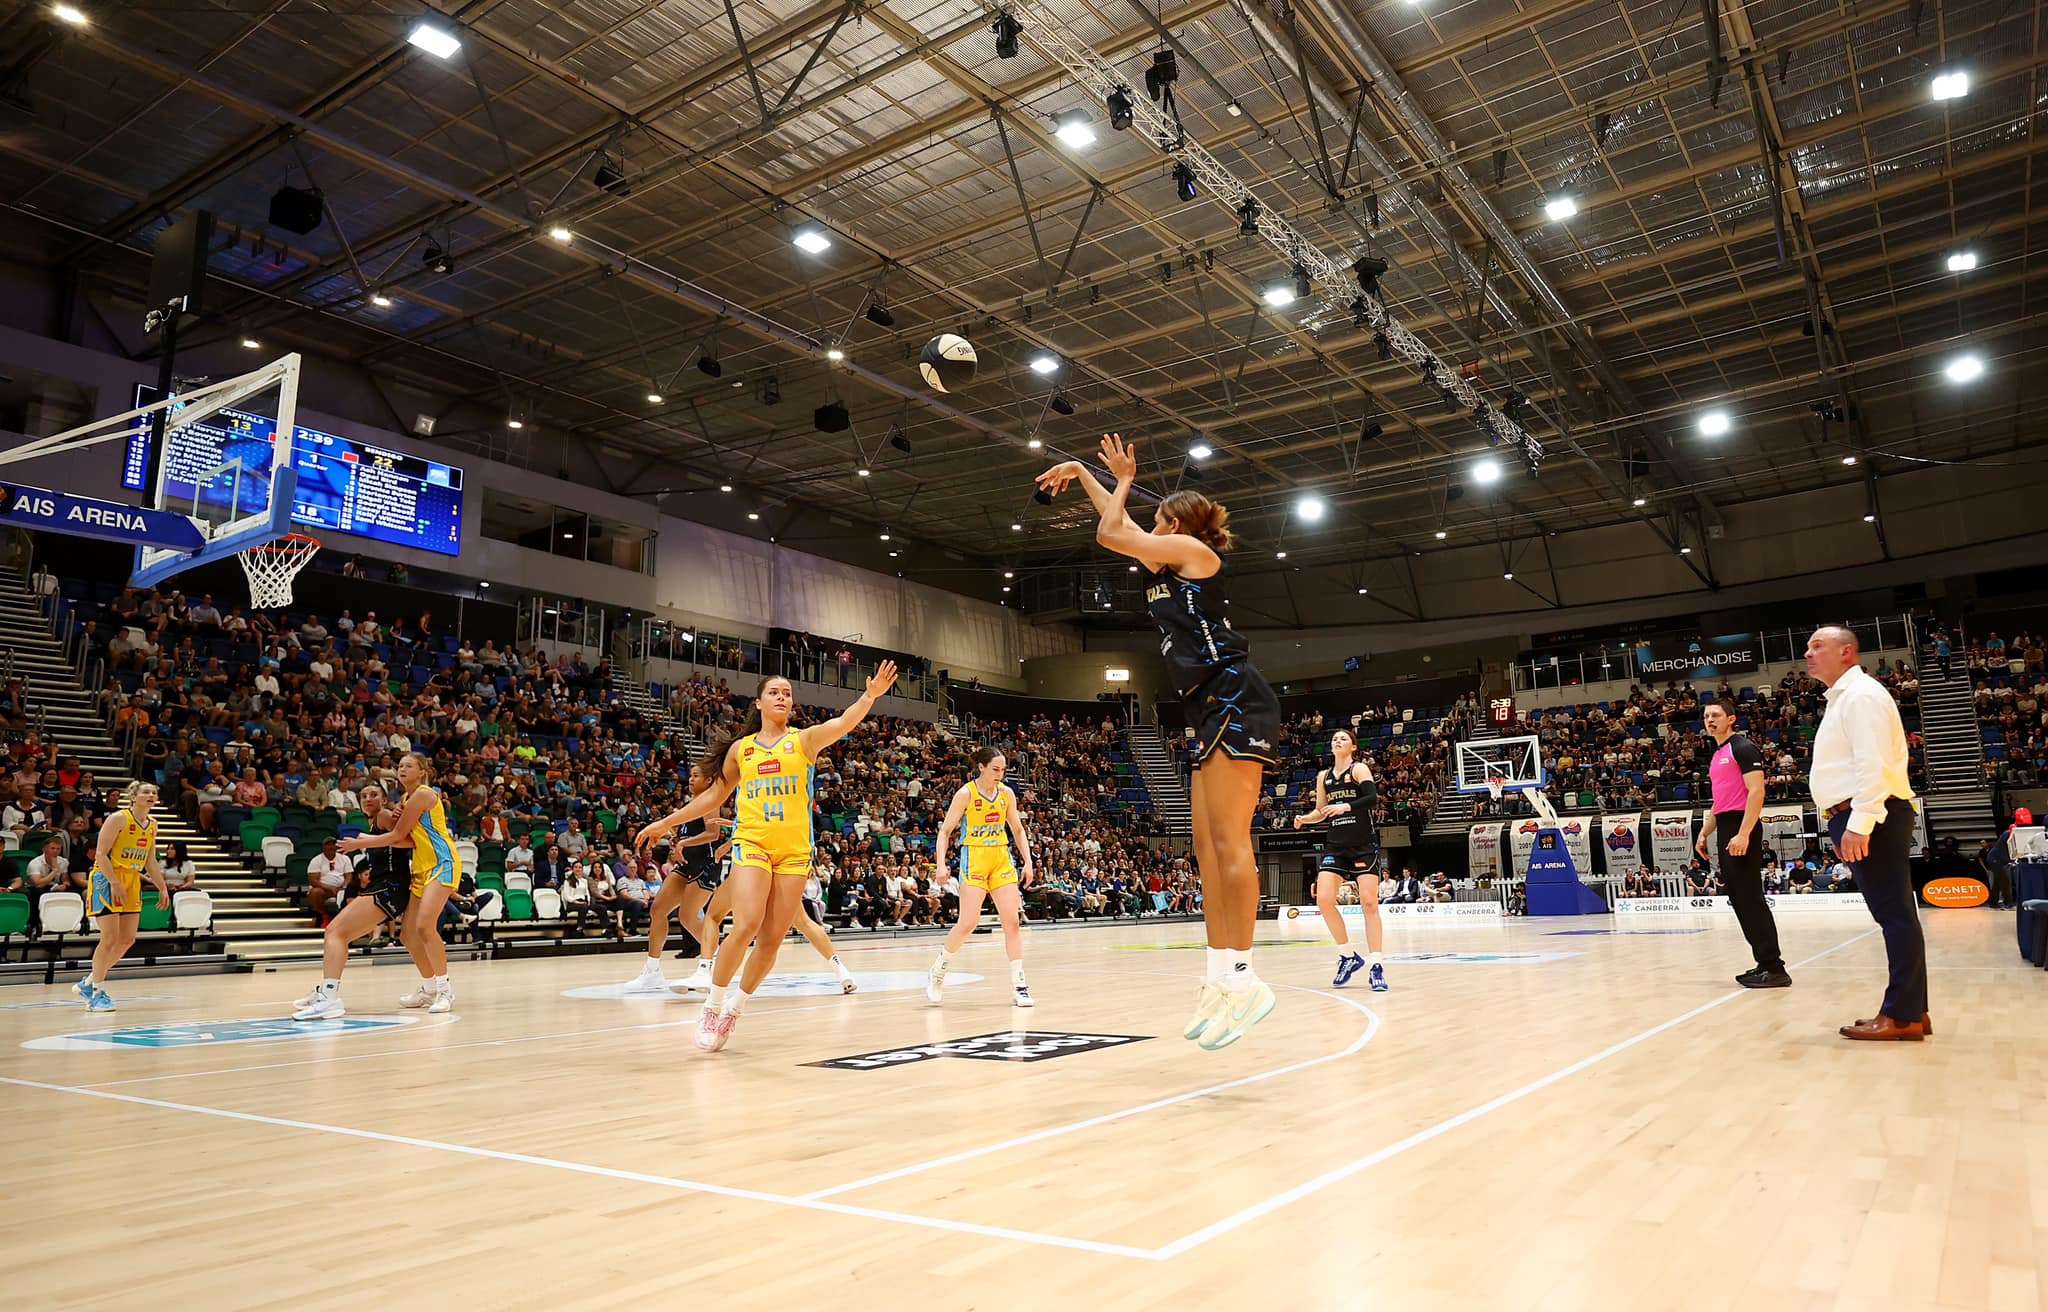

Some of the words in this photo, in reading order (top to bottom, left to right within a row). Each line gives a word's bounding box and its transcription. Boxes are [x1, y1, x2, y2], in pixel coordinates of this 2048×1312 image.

[218, 408, 265, 425] CAPITALS
[229, 419, 253, 431] 13
[297, 429, 334, 447] 2:39
[172, 438, 223, 454] Melbourne
[310, 454, 318, 464] 1
[364, 446, 404, 461] BENDIGO
[298, 460, 329, 471] Quarter
[373, 456, 393, 468] 22
[13, 495, 55, 517] AIS
[67, 506, 148, 532] ARENA
[297, 505, 317, 517] 18
[1642, 650, 1753, 673] MERCHANDISE
[1490, 698, 1511, 709] 2:38
[1495, 708, 1508, 721] 18
[746, 776, 800, 800] SPIRIT
[763, 801, 785, 822] 14
[1654, 828, 1689, 837] WNBL
[1927, 885, 1982, 895] CYGNETT
[1635, 904, 1680, 912] CANBERRA
